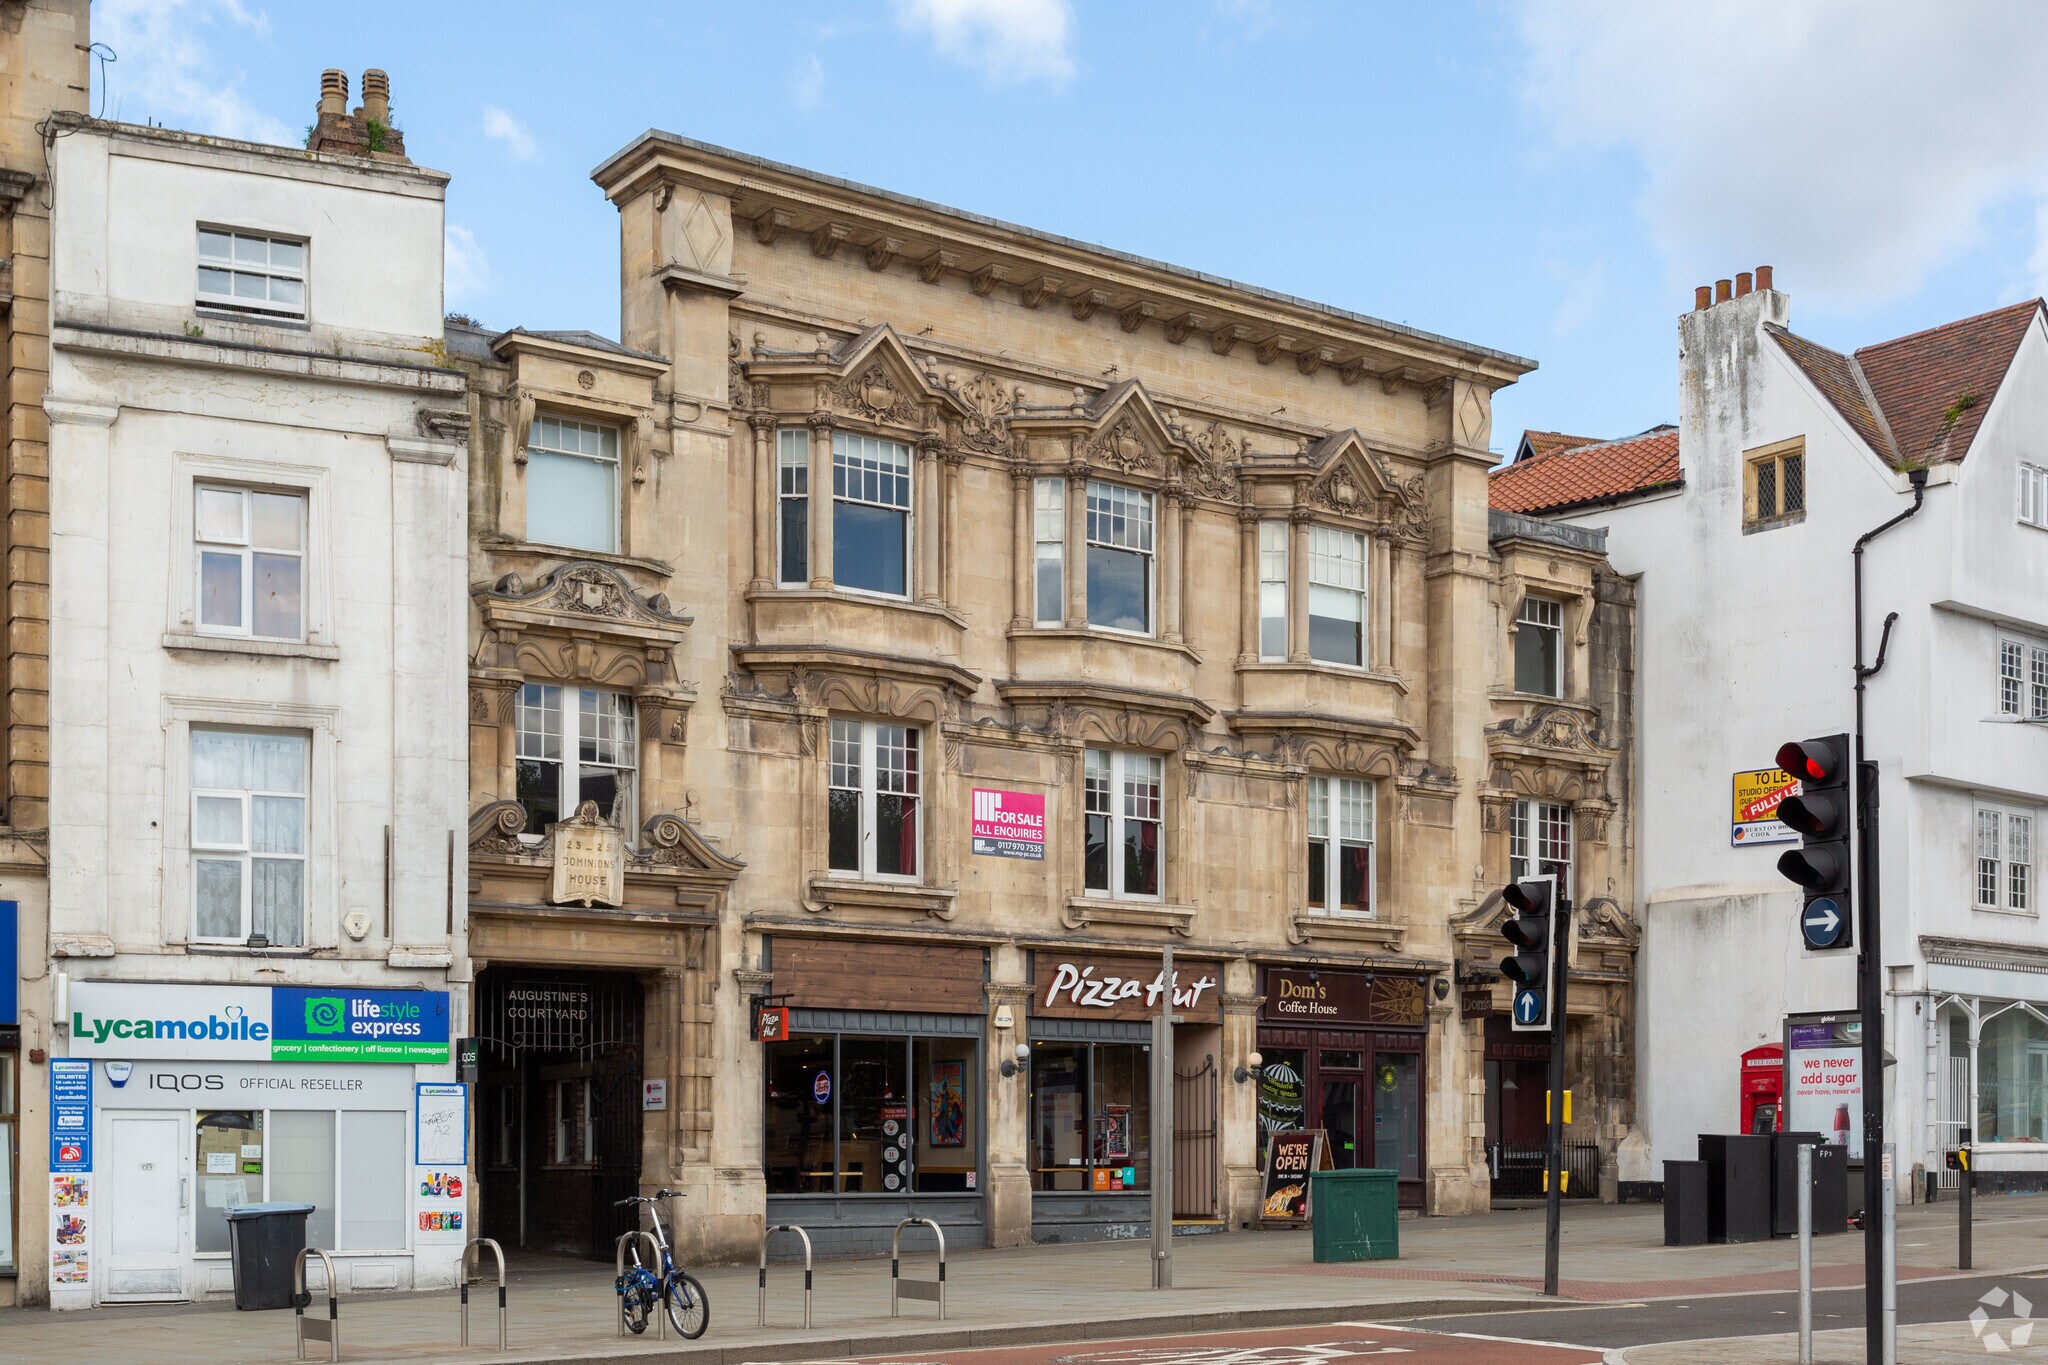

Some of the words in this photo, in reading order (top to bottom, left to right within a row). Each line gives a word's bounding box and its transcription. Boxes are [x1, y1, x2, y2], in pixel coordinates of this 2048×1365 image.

[1755, 772, 1770, 785] TO
[1738, 787, 1762, 797] STUDIO
[1750, 792, 1782, 816] FULLY
[1784, 783, 1799, 798] LE
[995, 810, 1016, 824] FOR
[1017, 813, 1043, 827] SALE
[974, 823, 992, 835] ALL
[994, 825, 1043, 840] ENQUIRIES
[1745, 825, 1777, 833] BURSTON
[566, 841, 582, 850] 23
[597, 843, 612, 852] 25
[997, 841, 1012, 849] 0117
[1013, 842, 1025, 851] 970
[1026, 844, 1042, 853] 7535
[562, 857, 616, 869] DOMINIONS
[569, 874, 607, 885] HOUSE
[1044, 963, 1142, 1008] Pizza
[1145, 970, 1216, 1008] Hut
[1279, 978, 1326, 1000] Dom's
[508, 990, 588, 1002] AUGUSTINE'S
[351, 999, 420, 1021] lifestyle
[508, 1007, 587, 1020] COURTYARD
[1278, 1000, 1308, 1013] Coffee
[1309, 1001, 1338, 1015] House
[73, 1007, 269, 1044] Lycamobile
[761, 1012, 779, 1026] Pizza
[1820, 1015, 1836, 1024] global
[351, 1020, 421, 1038] express
[762, 1025, 777, 1037] Hut
[273, 1045, 301, 1054] grocery
[308, 1044, 359, 1054] confectionery
[365, 1045, 377, 1053] off
[377, 1045, 402, 1054] licence
[408, 1046, 448, 1056] newsagent
[1803, 1060, 1820, 1069] we
[1823, 1058, 1855, 1068] never
[149, 1073, 224, 1093] IQOS
[239, 1078, 296, 1090] OFFICIAL
[300, 1079, 363, 1091] RESELLER
[1800, 1071, 1823, 1085] add
[1825, 1073, 1857, 1087] sugar
[1278, 1143, 1309, 1156] WE'RE
[1275, 1156, 1308, 1171] OPEN
